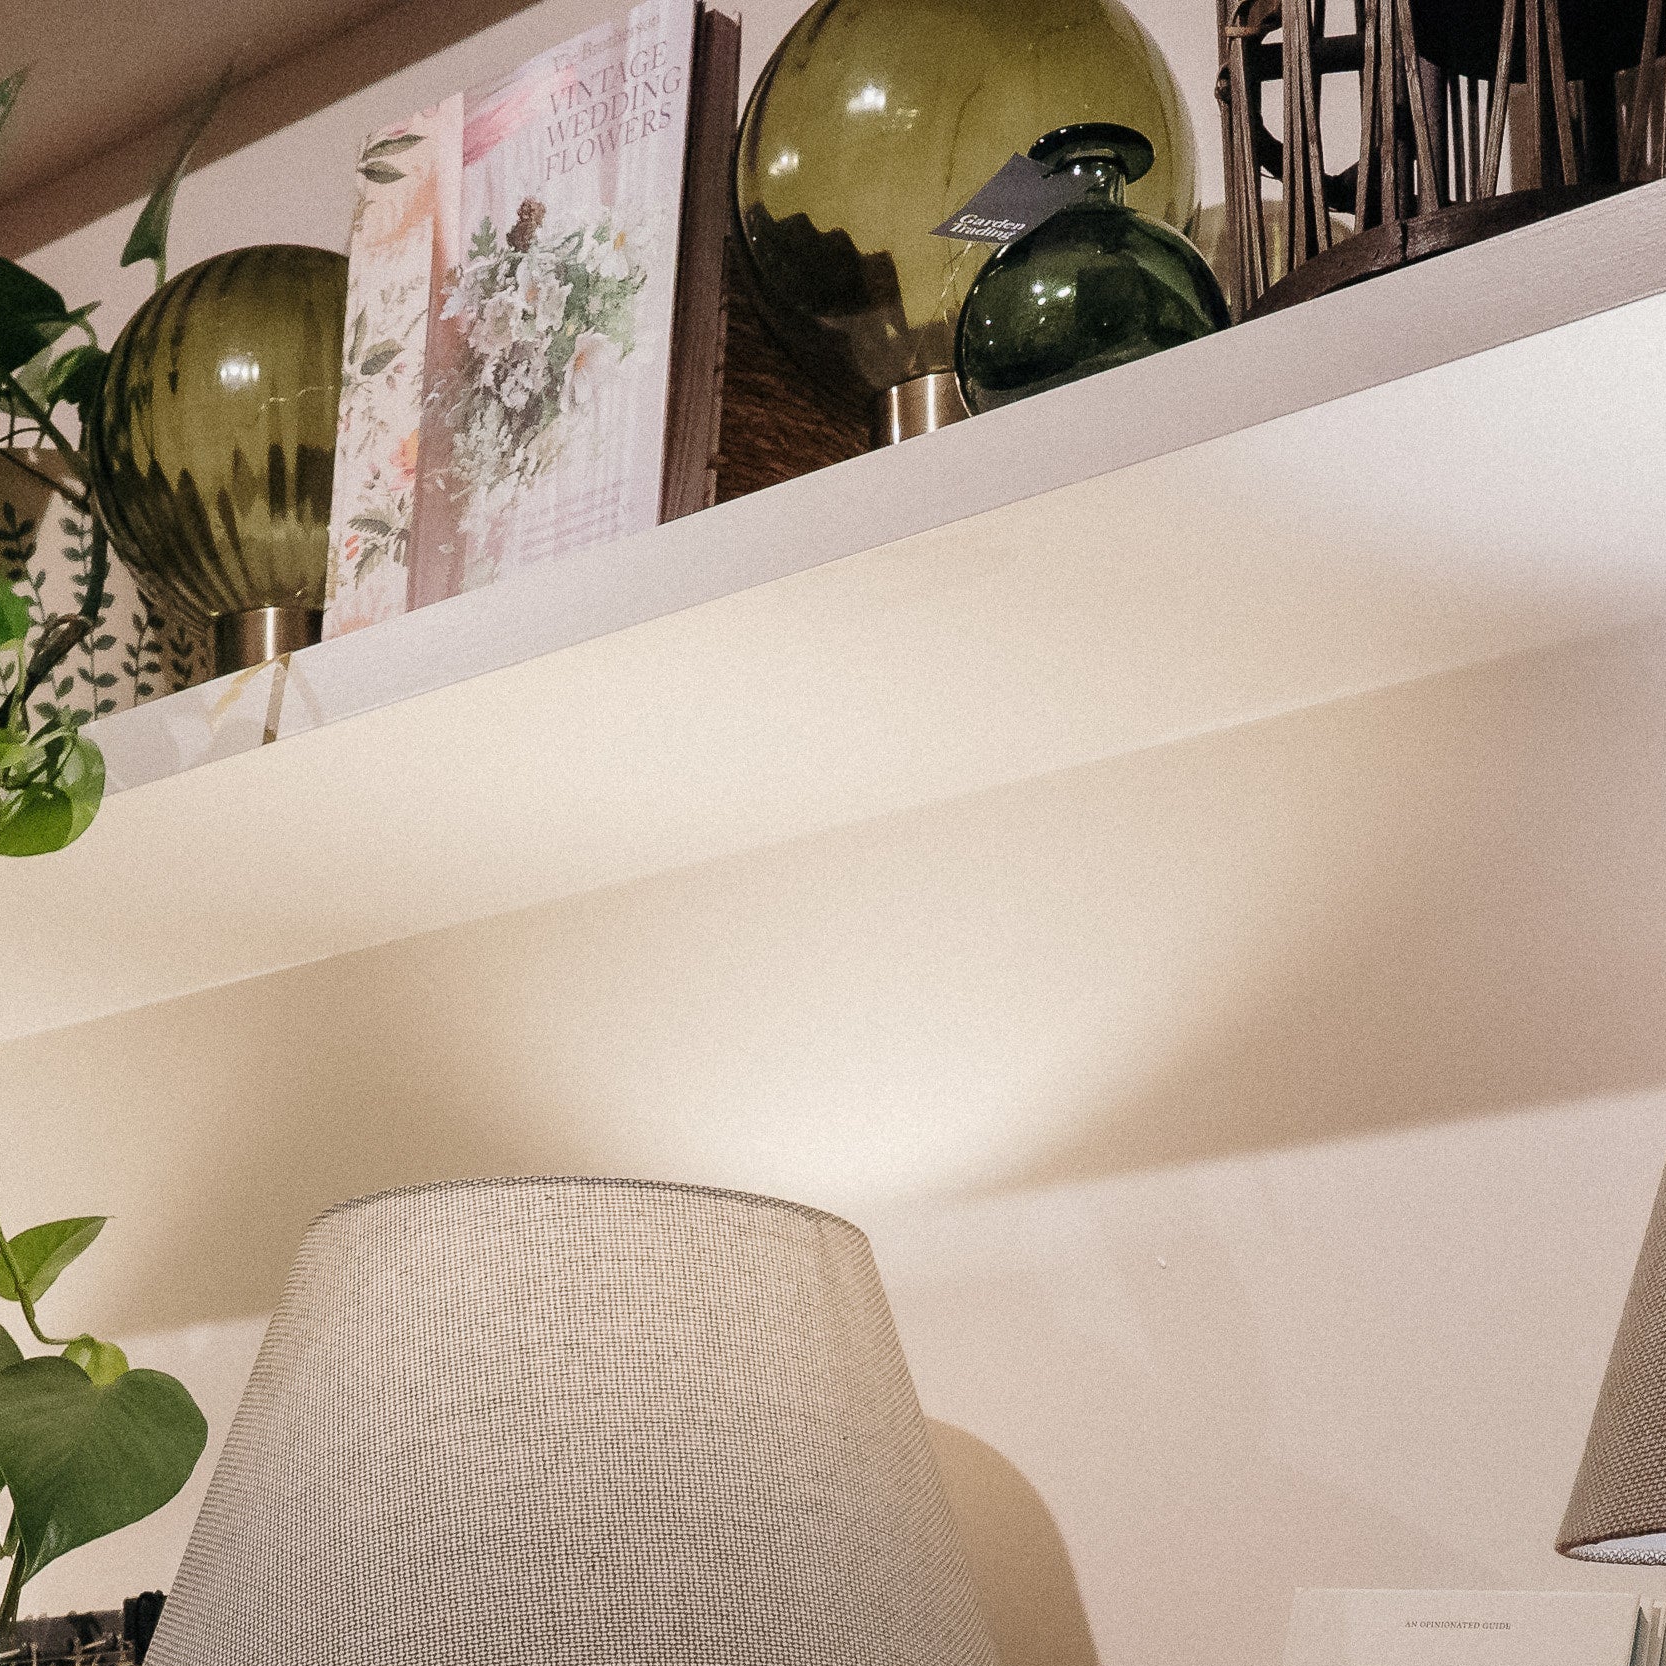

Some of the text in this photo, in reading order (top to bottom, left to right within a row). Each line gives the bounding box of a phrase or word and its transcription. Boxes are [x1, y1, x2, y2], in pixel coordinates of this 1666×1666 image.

[550, 41, 667, 115] VINTAGE
[547, 66, 681, 147] WEDDING
[546, 101, 672, 180] FLOWERS
[949, 222, 1017, 241] Trading
[959, 213, 1026, 231] Garden
[1404, 1620, 1512, 1630] AN OPINIONATED GUIDE
